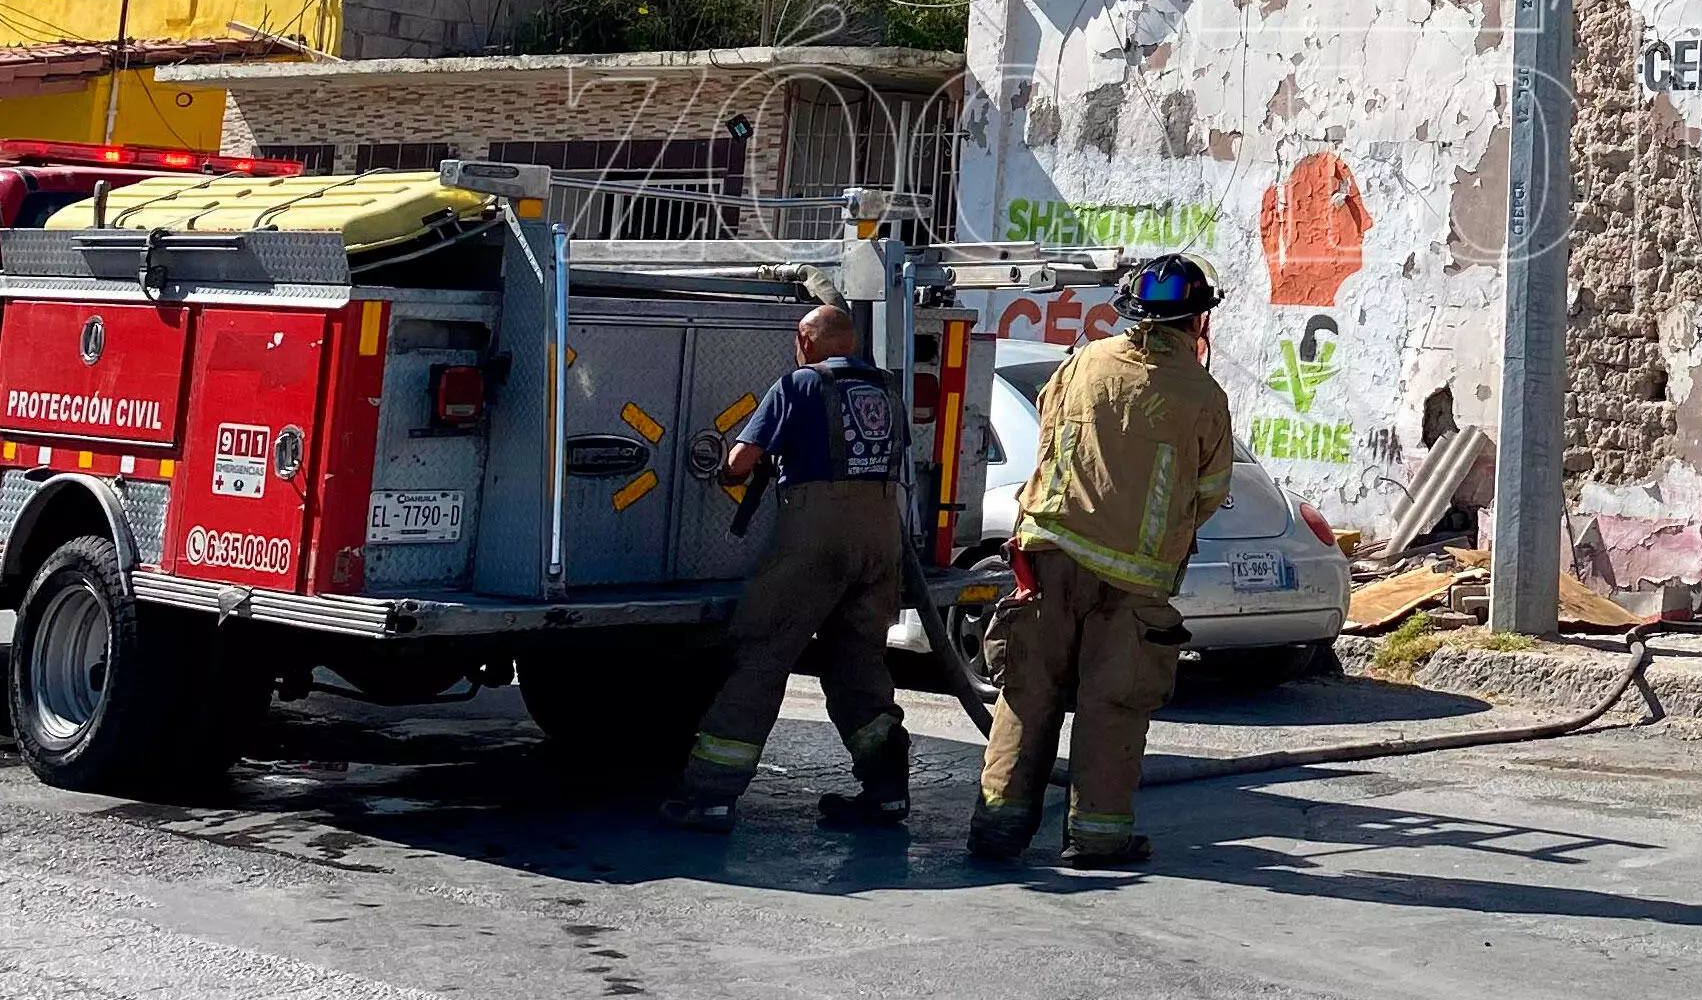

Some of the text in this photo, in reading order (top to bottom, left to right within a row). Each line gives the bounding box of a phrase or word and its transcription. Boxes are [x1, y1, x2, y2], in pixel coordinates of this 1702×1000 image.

[7, 390, 163, 431] PROTECCIÓN CIVIL
[220, 430, 265, 456] 911
[204, 529, 290, 573] 6.35.08.08
